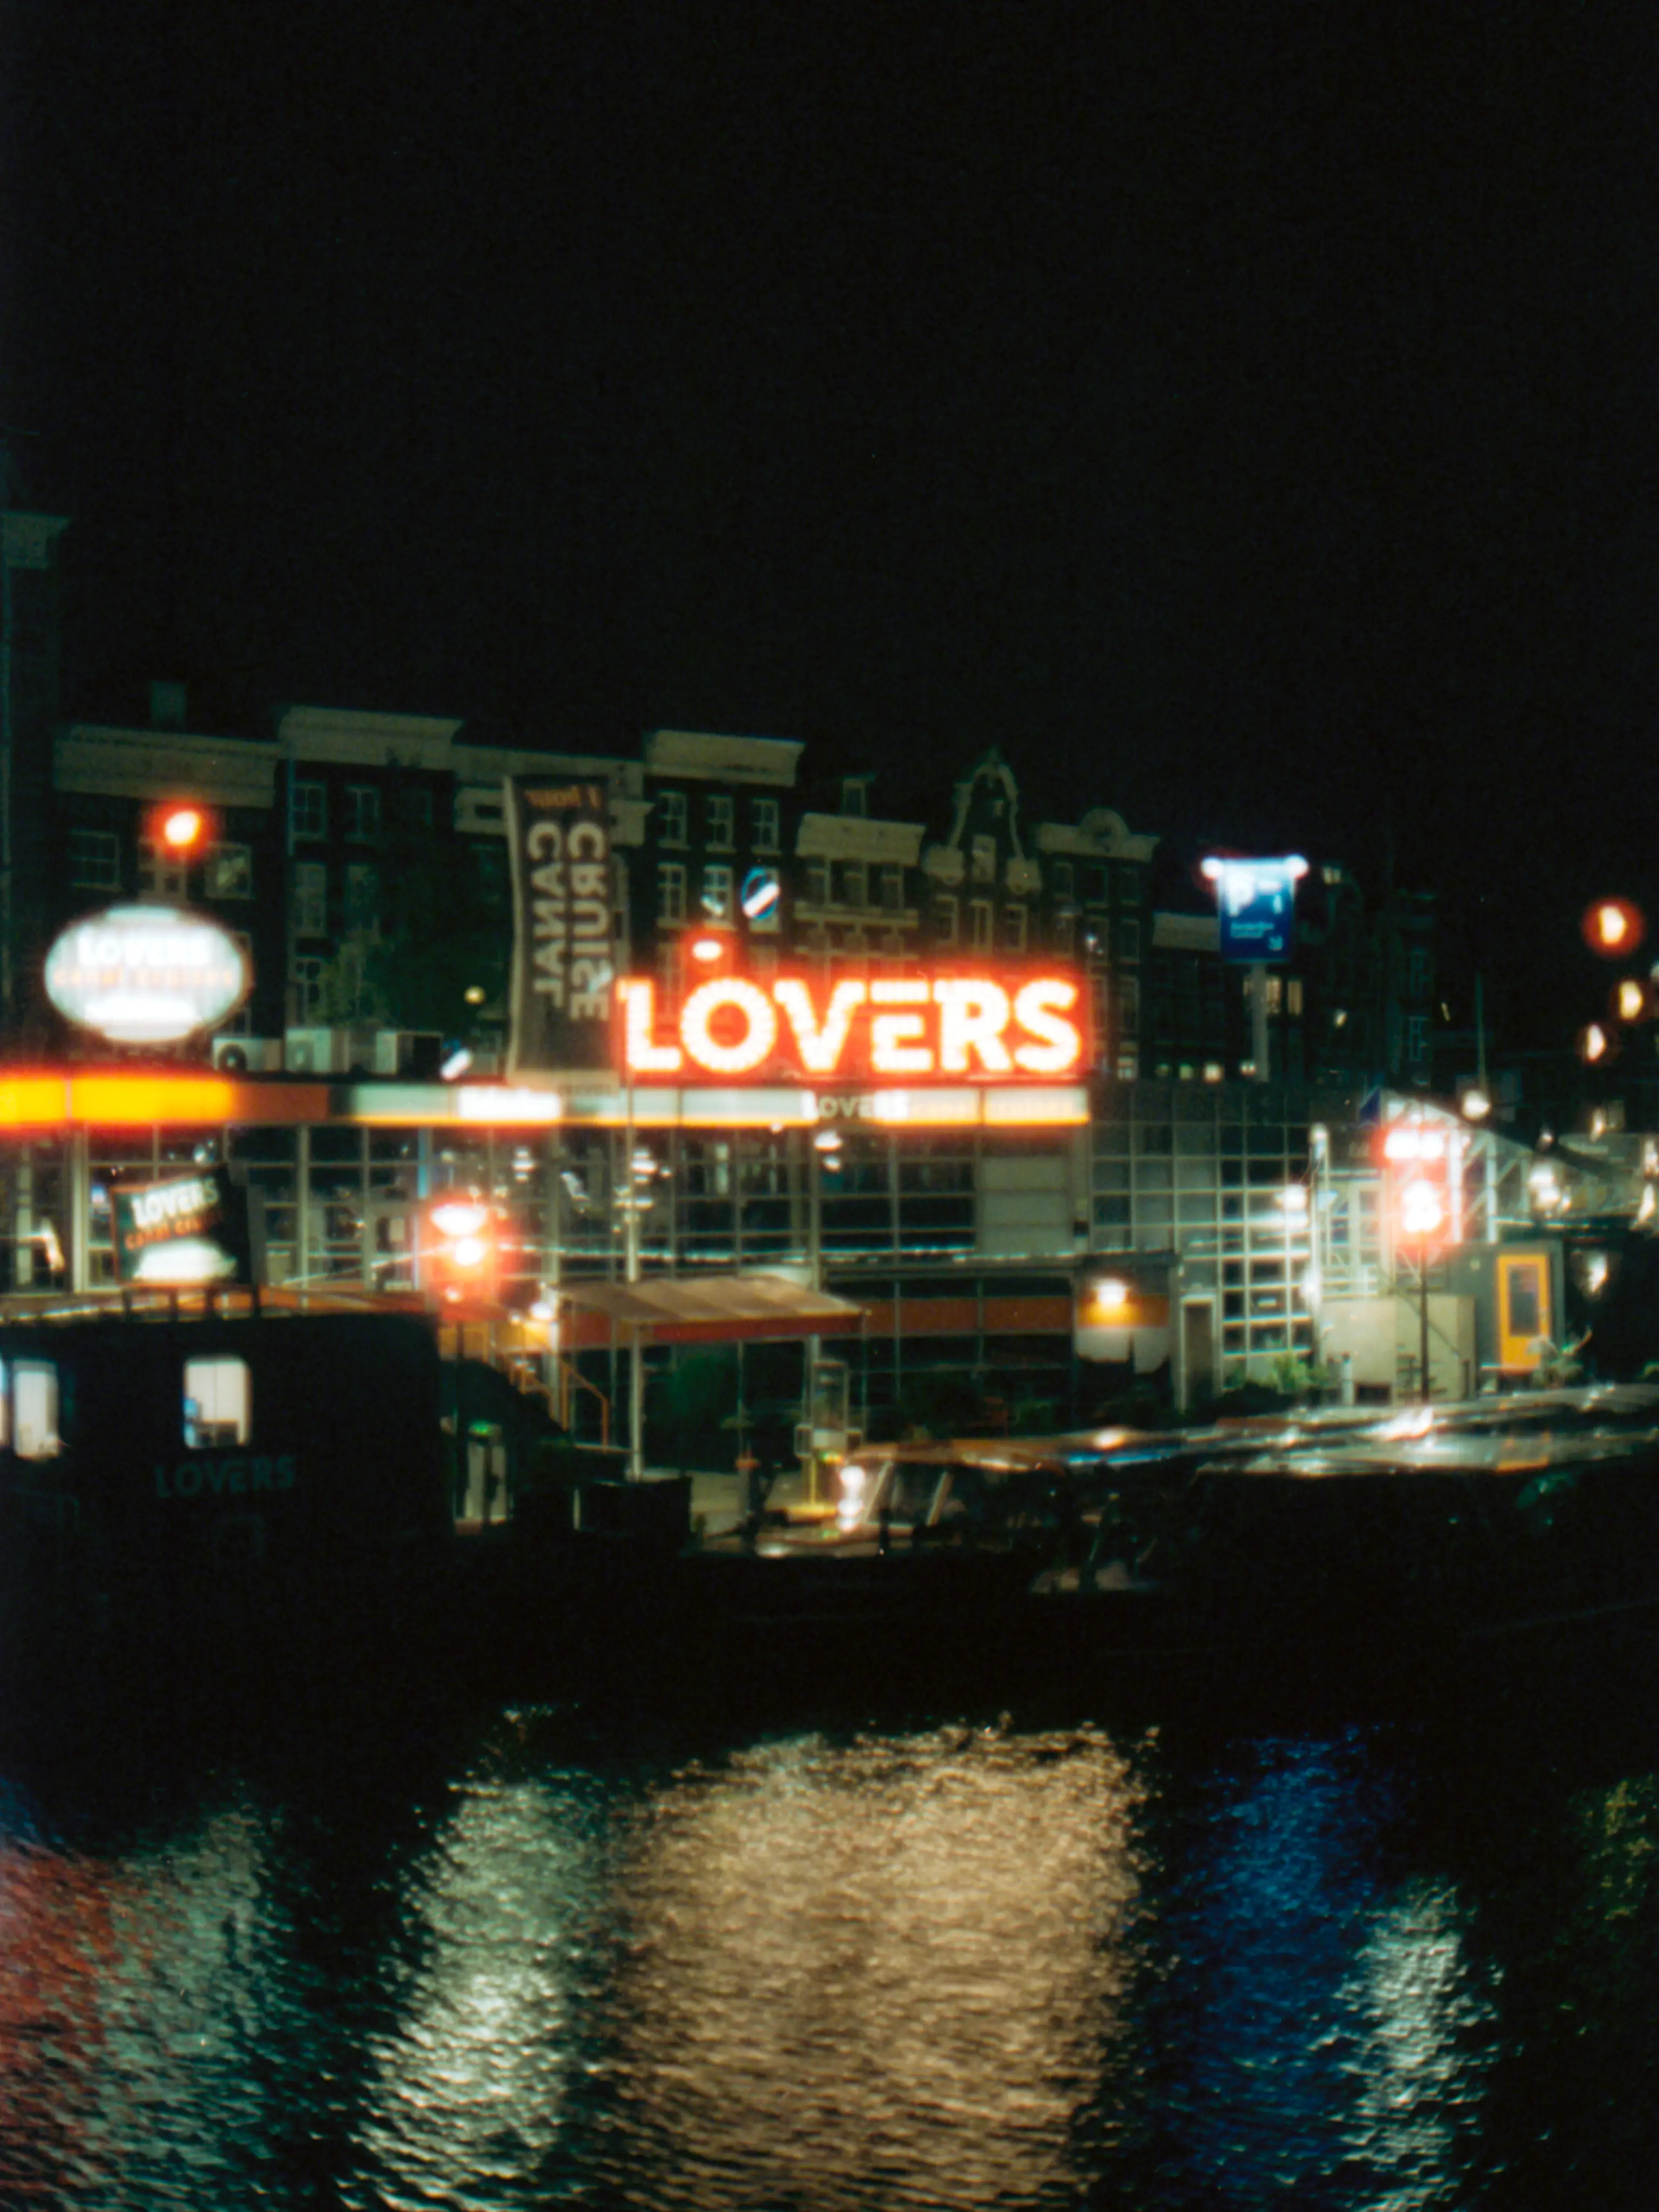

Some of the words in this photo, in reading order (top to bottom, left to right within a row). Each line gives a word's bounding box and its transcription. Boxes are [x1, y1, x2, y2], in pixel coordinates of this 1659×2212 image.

[617, 976, 1082, 1074] LOVERS
[802, 1091, 908, 1120] LOVE
[131, 1176, 219, 1228] LOVERS
[153, 1455, 297, 1499] LOVERS
